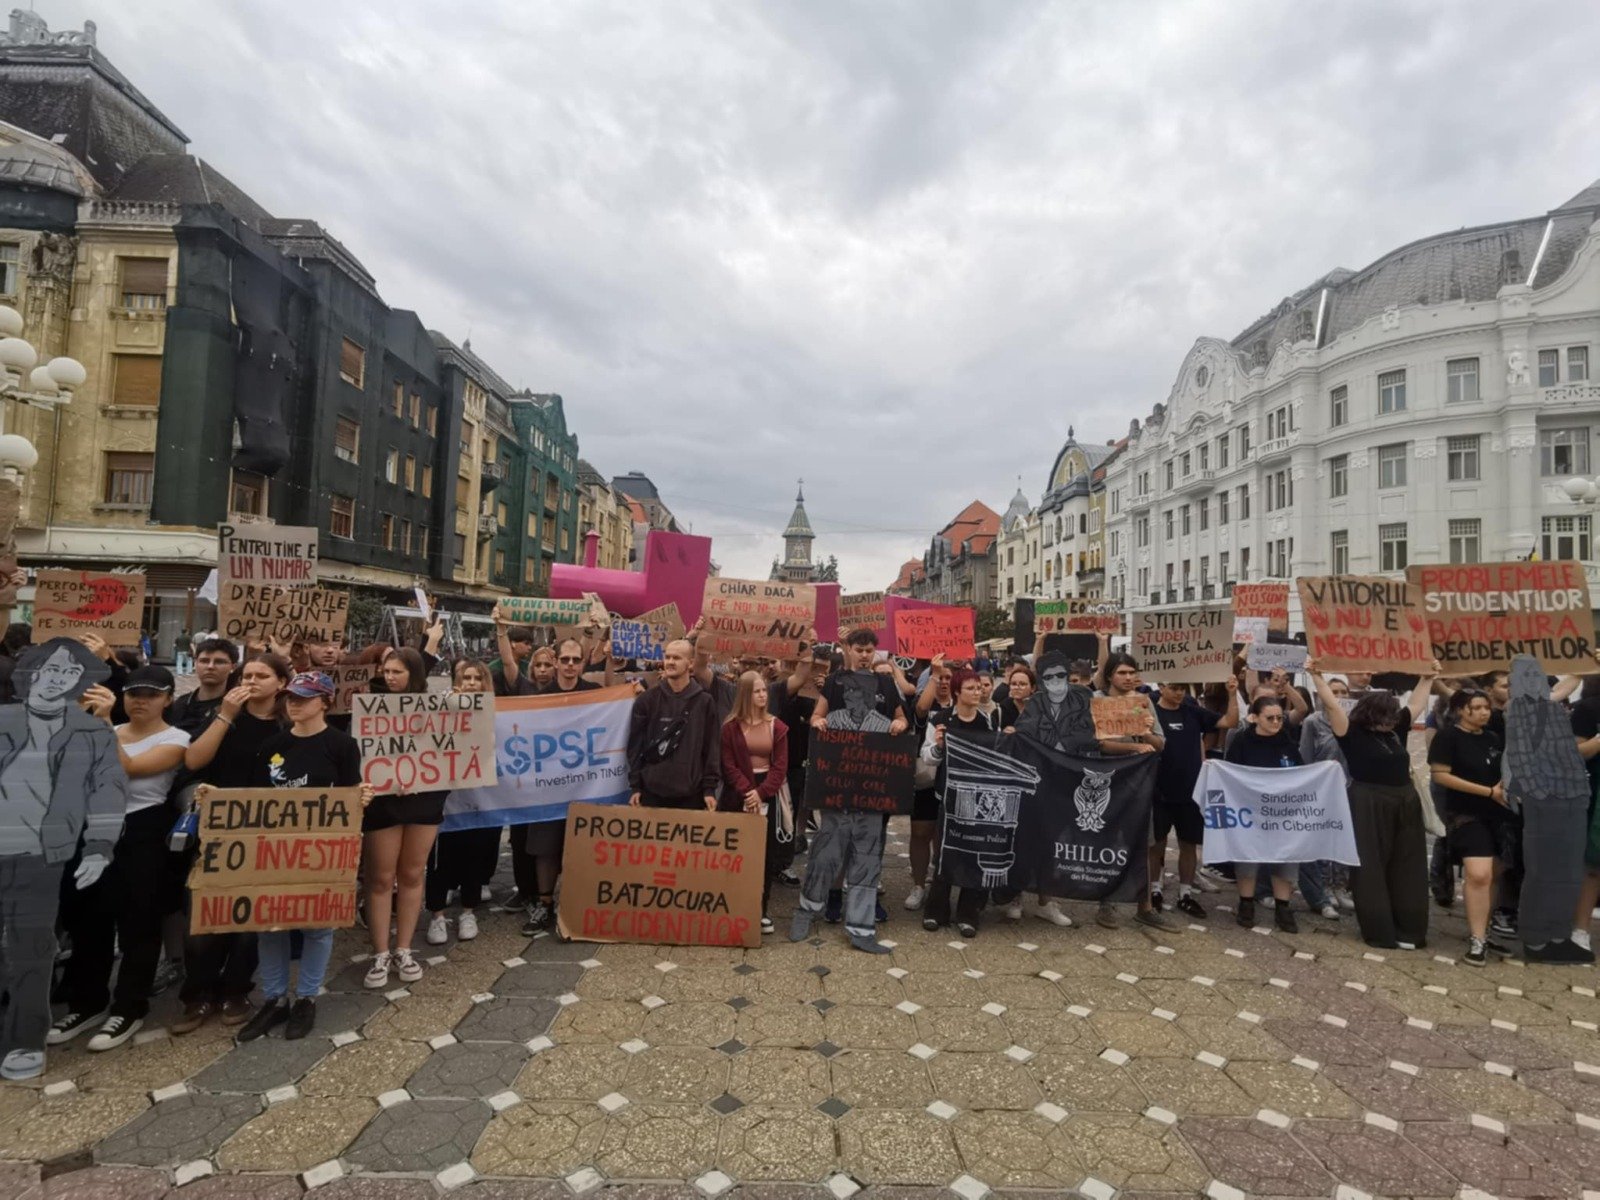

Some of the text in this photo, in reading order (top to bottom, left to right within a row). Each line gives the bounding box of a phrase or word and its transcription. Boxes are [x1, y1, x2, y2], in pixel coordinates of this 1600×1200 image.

[219, 525, 316, 559] PENTRU TINE E
[230, 556, 254, 579] UN
[1421, 564, 1579, 593] PROBLEMELE
[52, 592, 69, 603] SE
[231, 584, 348, 610] DREPTURILE
[720, 582, 757, 596] CHIAR
[1307, 577, 1416, 608] VIITORUL
[242, 601, 336, 623] NU SUNT
[559, 601, 593, 613] BUGET
[711, 599, 727, 611] PE
[38, 618, 139, 630] PE STOMACUL GOL
[511, 610, 538, 623] NOI
[901, 616, 935, 626] VREM
[1335, 607, 1399, 631] NU E
[612, 631, 651, 643] BUGET
[767, 618, 805, 640] NU
[898, 637, 915, 654] NU
[1197, 640, 1214, 650] LA
[1314, 633, 1431, 661] NEGOCIABIL
[358, 694, 389, 714] VĂ
[458, 693, 484, 711] DE
[361, 732, 455, 757] PÂNĂ VĂ
[364, 745, 481, 792] COSTĂ
[535, 772, 585, 788] Investim
[1260, 792, 1317, 804] Sindicatul
[574, 816, 740, 851] PROBLEMELE
[1261, 820, 1279, 831] din
[203, 837, 223, 873] E
[226, 840, 246, 871] O
[1054, 841, 1128, 866] PHILOS
[597, 880, 730, 915] BATJOCURA
[200, 896, 233, 926] NU
[232, 896, 252, 925] O
[582, 908, 751, 945] DECIDENTILOR
